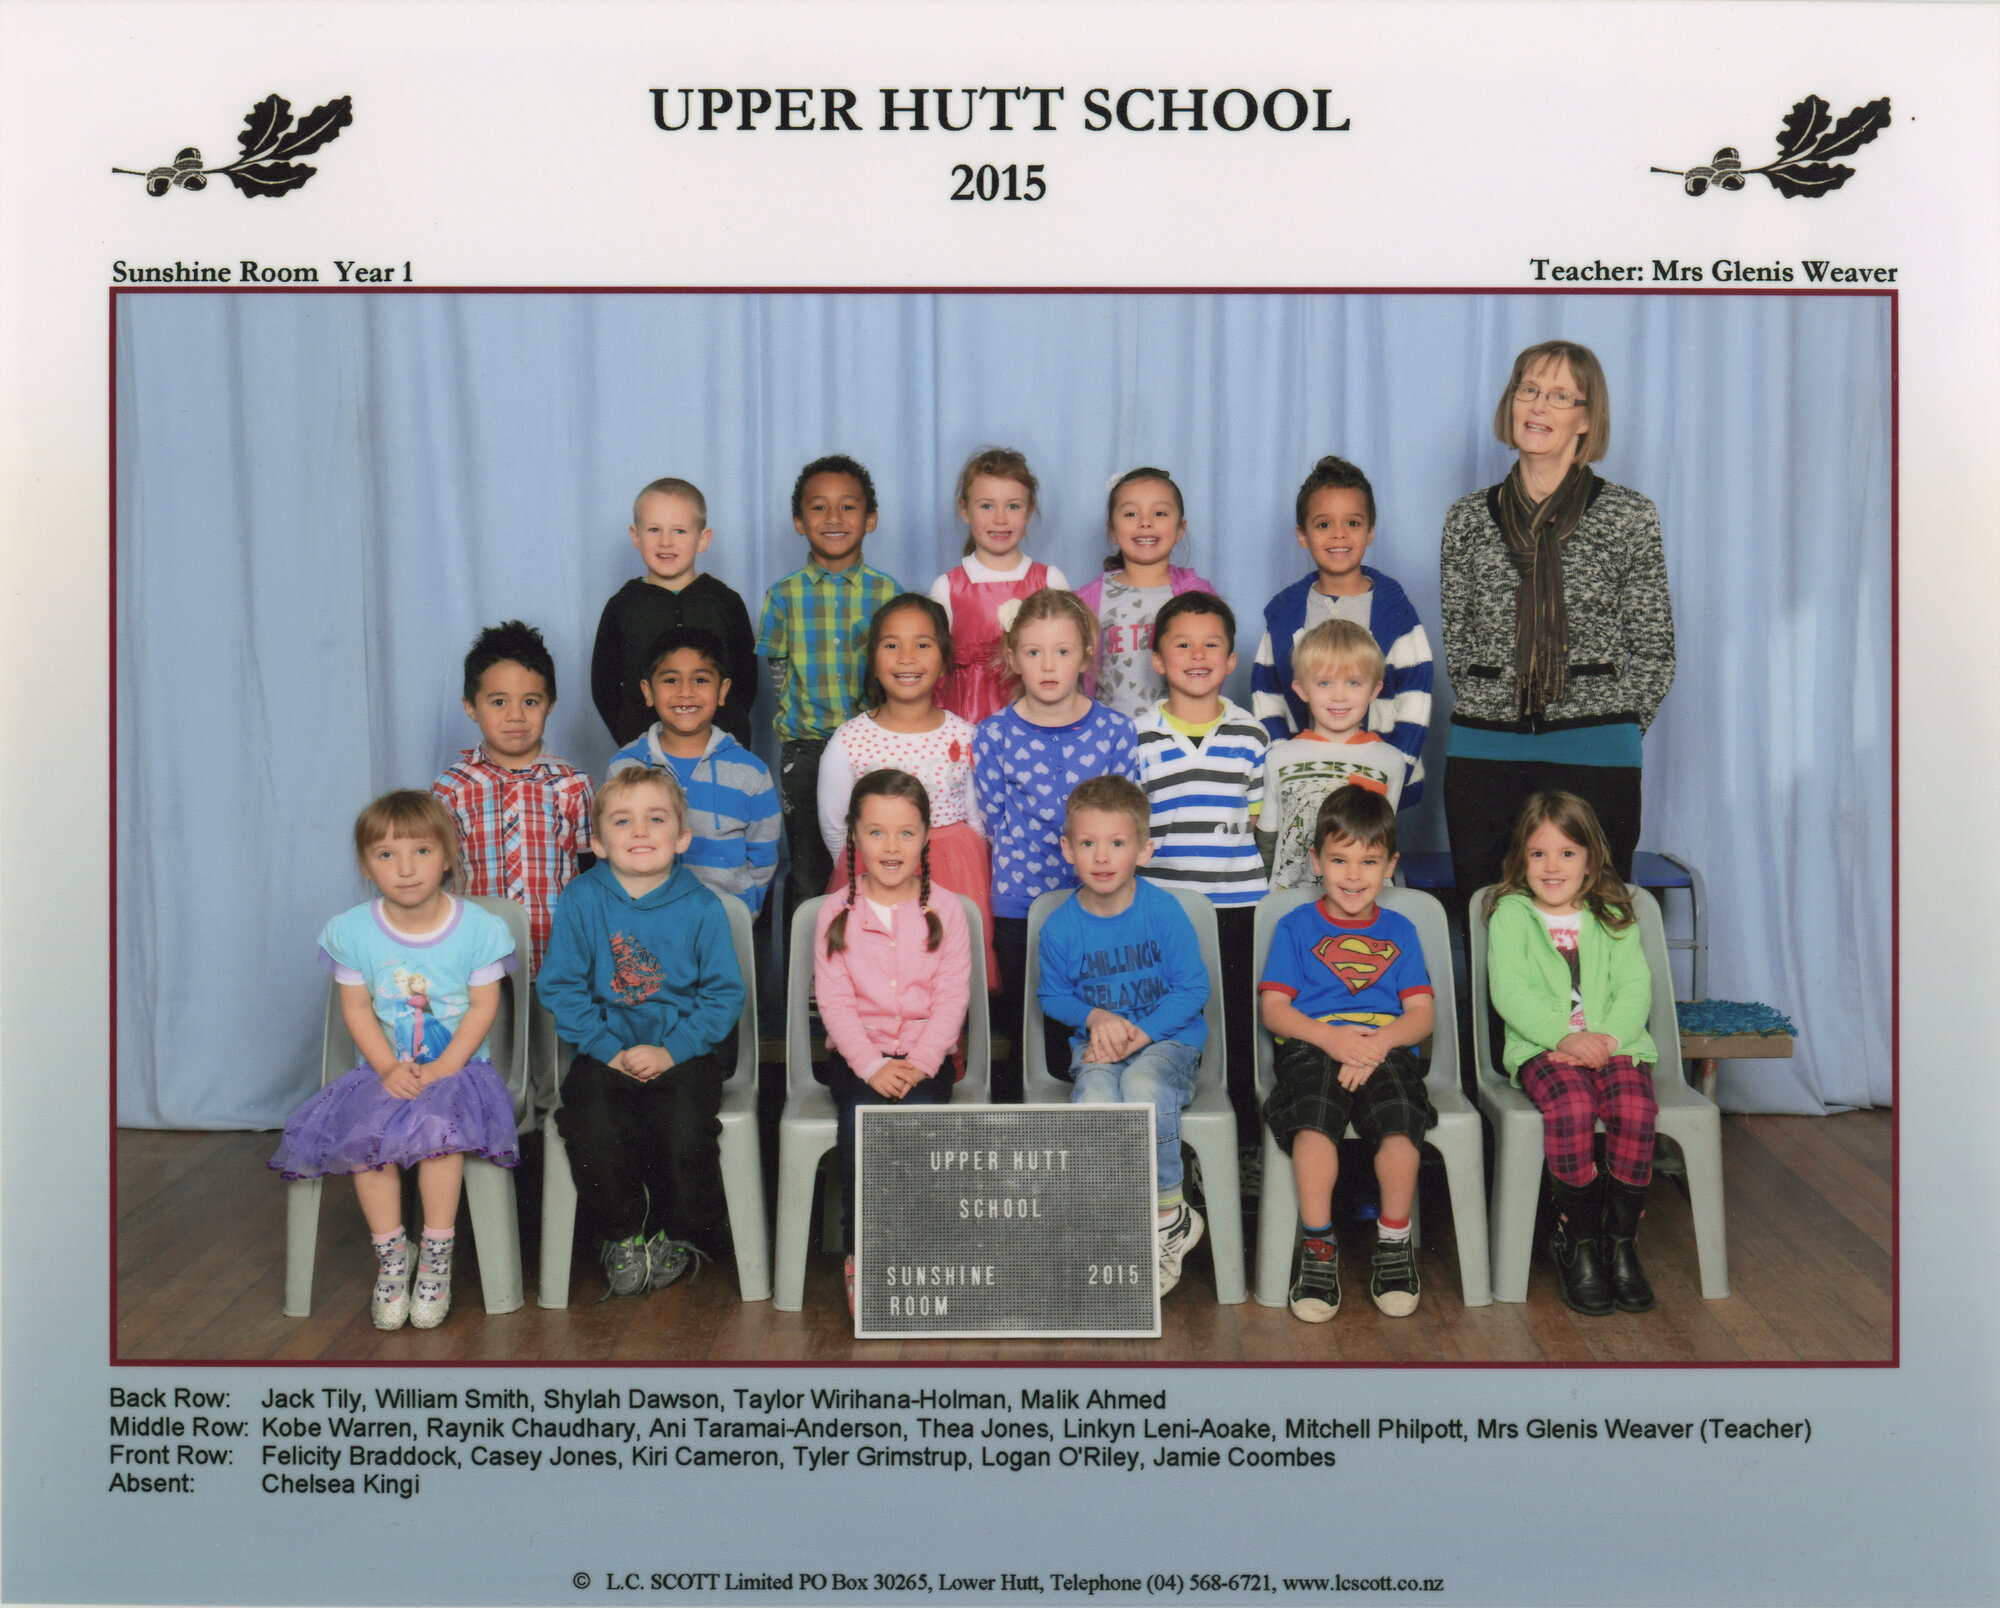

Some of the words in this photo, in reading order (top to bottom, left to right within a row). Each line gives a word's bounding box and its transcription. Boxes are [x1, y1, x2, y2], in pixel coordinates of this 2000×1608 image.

[1107, 626, 1124, 654] JE
[930, 1150, 998, 1170] UPPER
[1013, 1150, 1069, 1170] HUTT
[959, 1198, 1042, 1219] SCHOOL
[886, 1265, 996, 1287] SUNSHINE
[1088, 1264, 1140, 1286] 2015
[889, 1295, 949, 1317] ROOM
